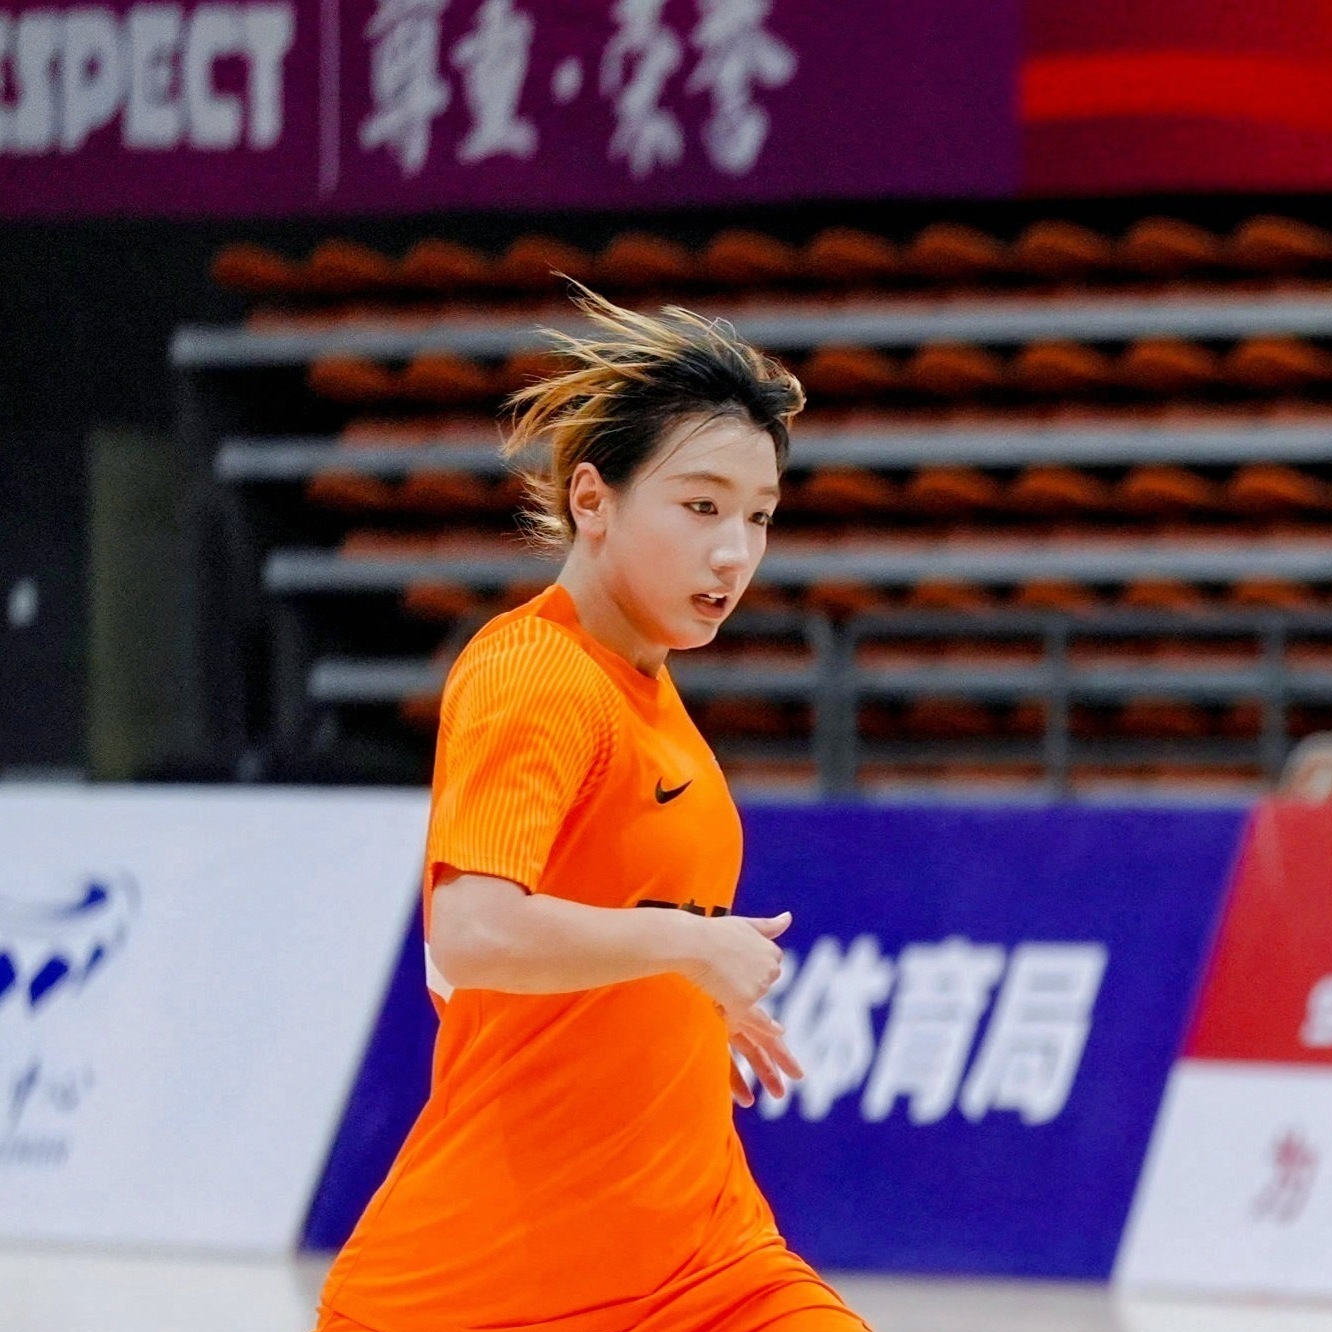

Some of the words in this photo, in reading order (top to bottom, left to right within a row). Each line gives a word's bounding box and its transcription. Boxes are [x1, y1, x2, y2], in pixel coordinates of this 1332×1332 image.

[0, 4, 294, 152] SPECT
[745, 934, 1108, 1125] 体育局
